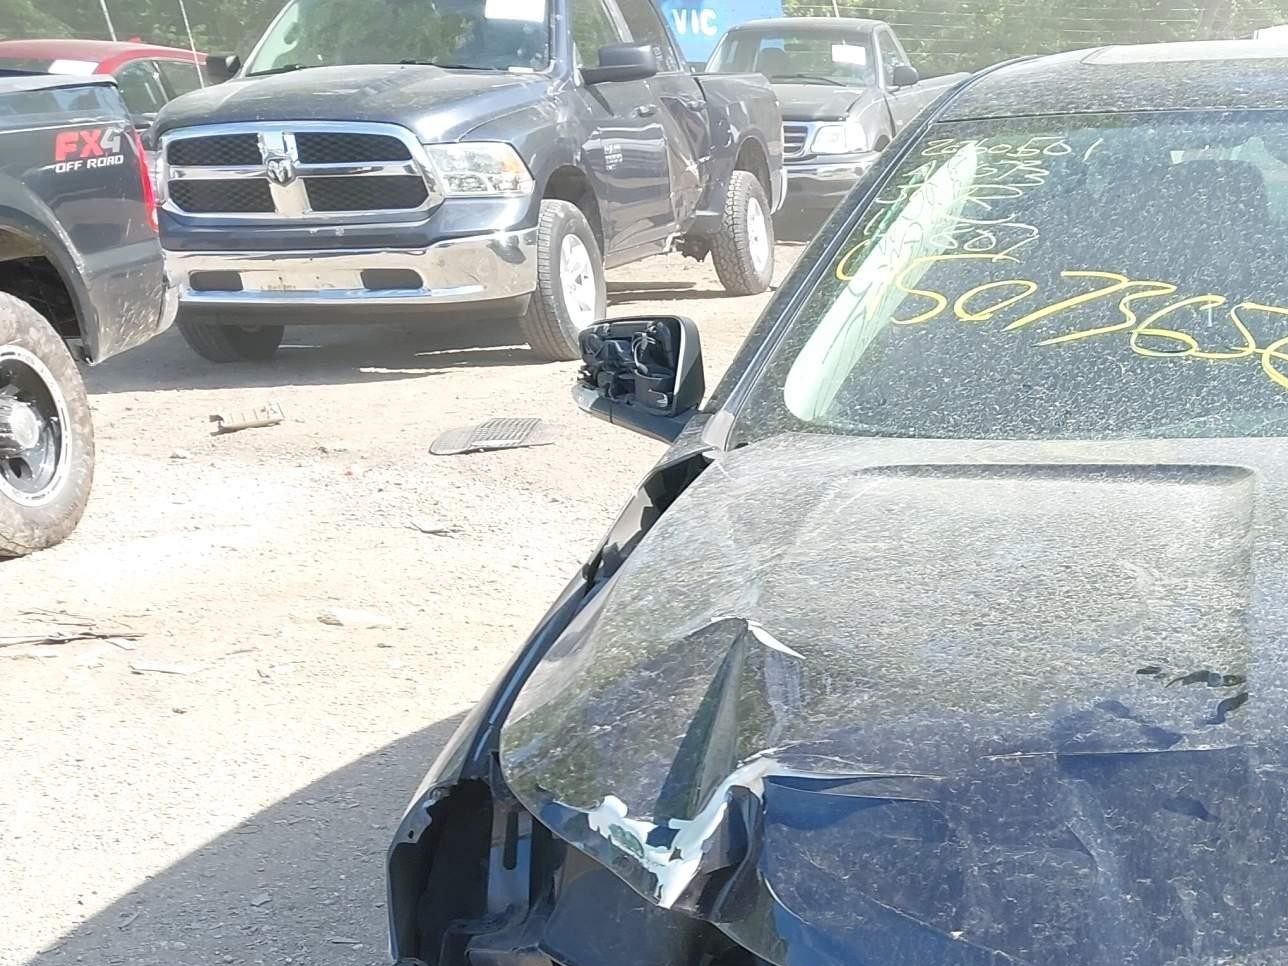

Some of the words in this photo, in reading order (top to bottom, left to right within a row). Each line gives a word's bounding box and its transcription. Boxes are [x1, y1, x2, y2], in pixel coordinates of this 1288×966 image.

[671, 8, 718, 36] VIC
[54, 126, 122, 161] FX4
[55, 160, 84, 173] OFF
[86, 154, 124, 169] ROAD
